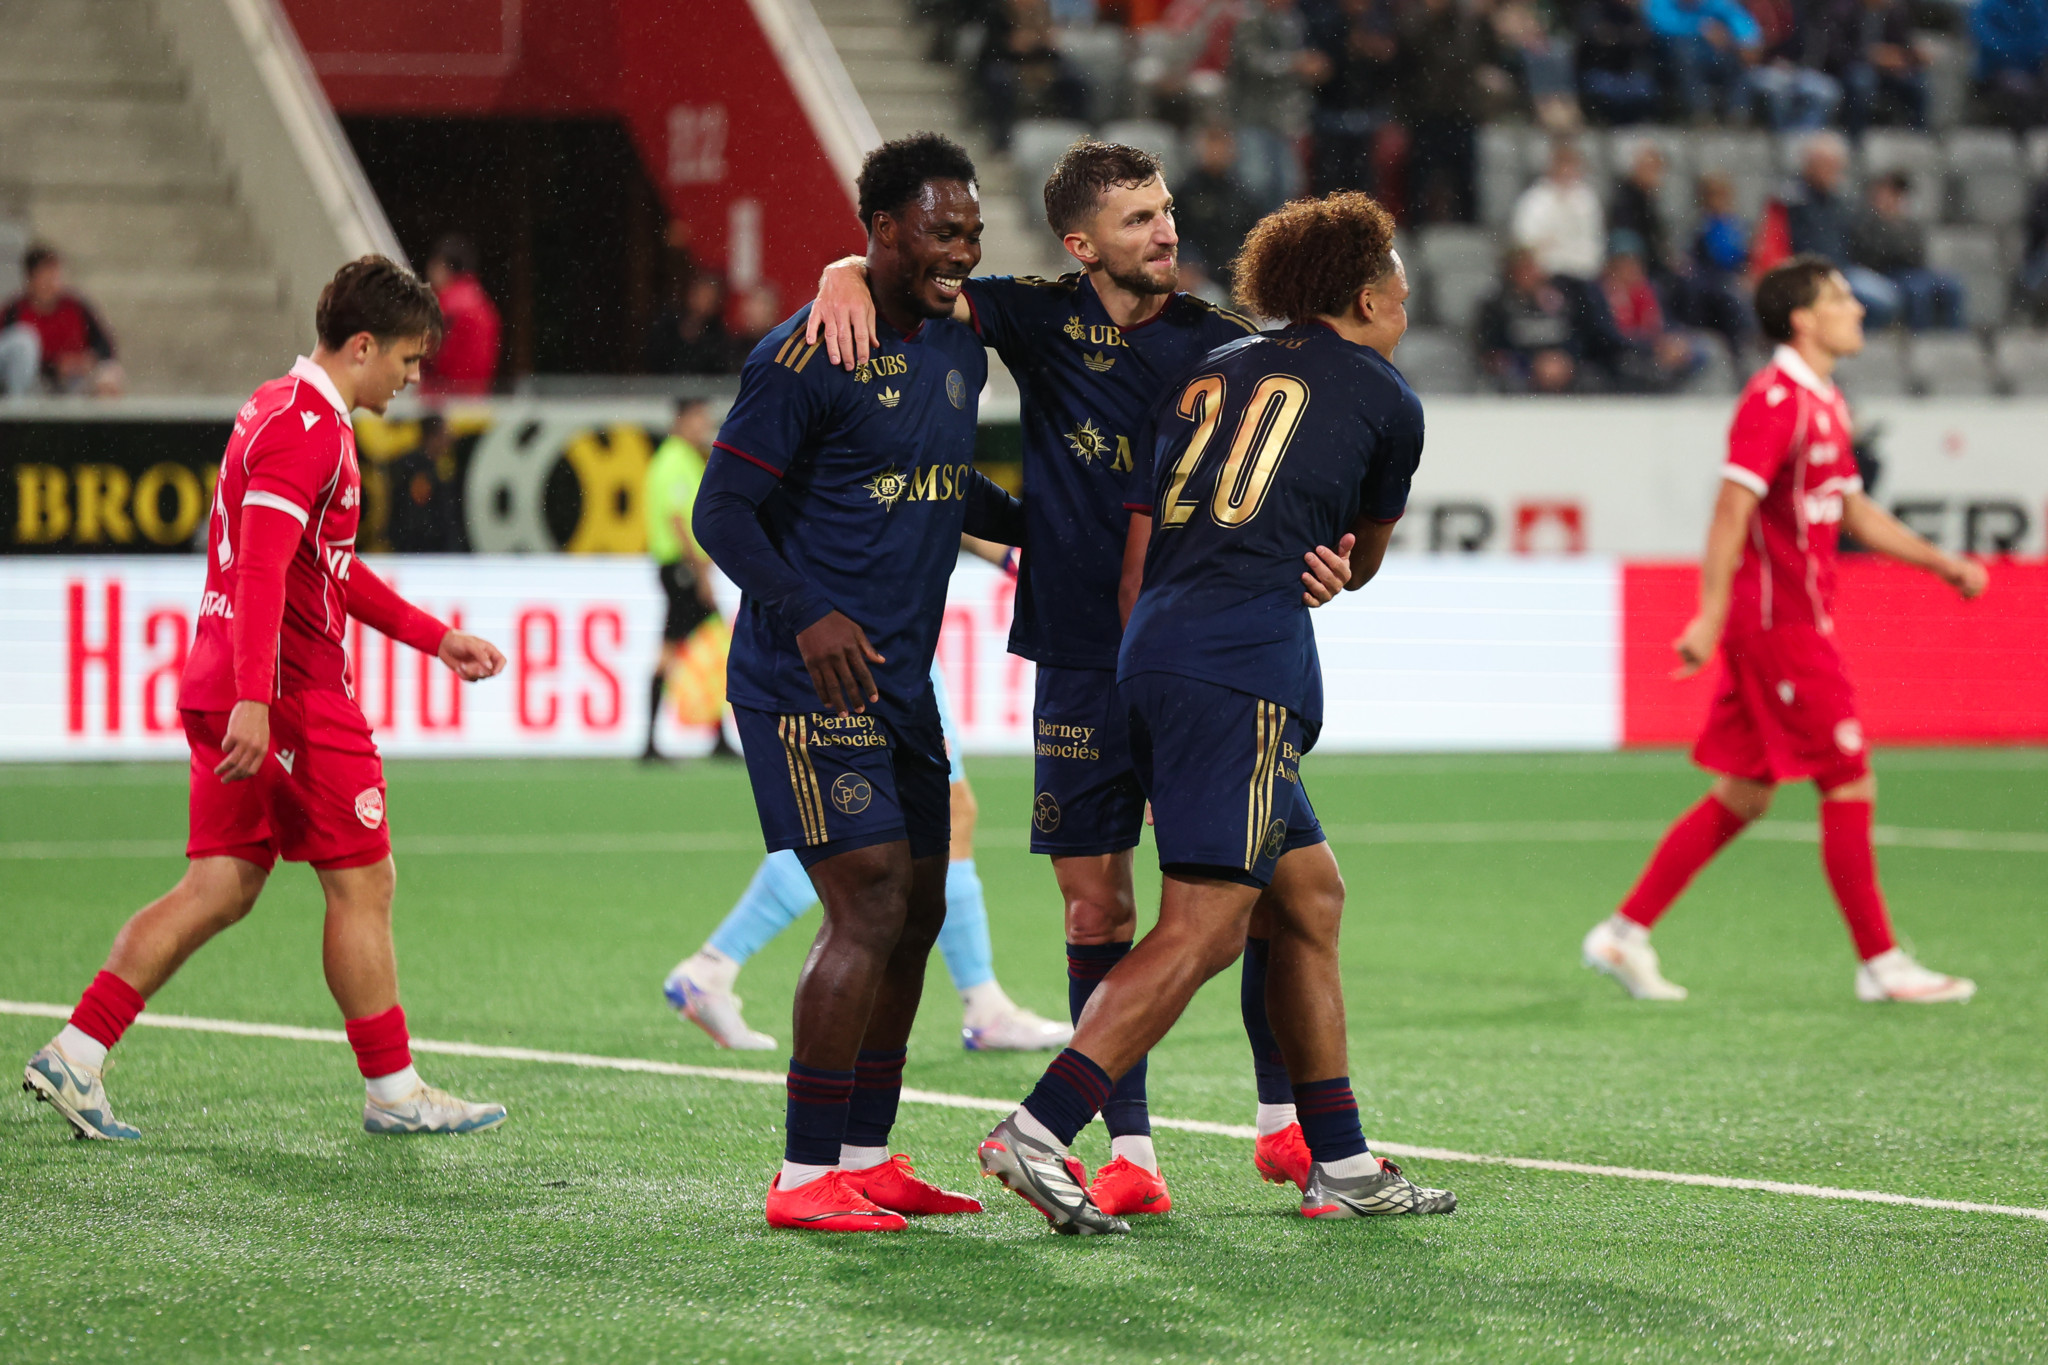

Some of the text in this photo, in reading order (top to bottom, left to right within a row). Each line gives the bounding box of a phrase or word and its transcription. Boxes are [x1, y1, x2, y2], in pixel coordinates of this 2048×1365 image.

[871, 354, 908, 377] UBS
[1161, 373, 1310, 529] 20
[907, 463, 968, 501] MSC
[66, 580, 189, 734] Ha
[517, 604, 624, 732] es
[811, 712, 875, 730] Berney
[1038, 718, 1095, 743] Berney
[808, 729, 887, 747] Associés
[1035, 739, 1100, 760] Associés
